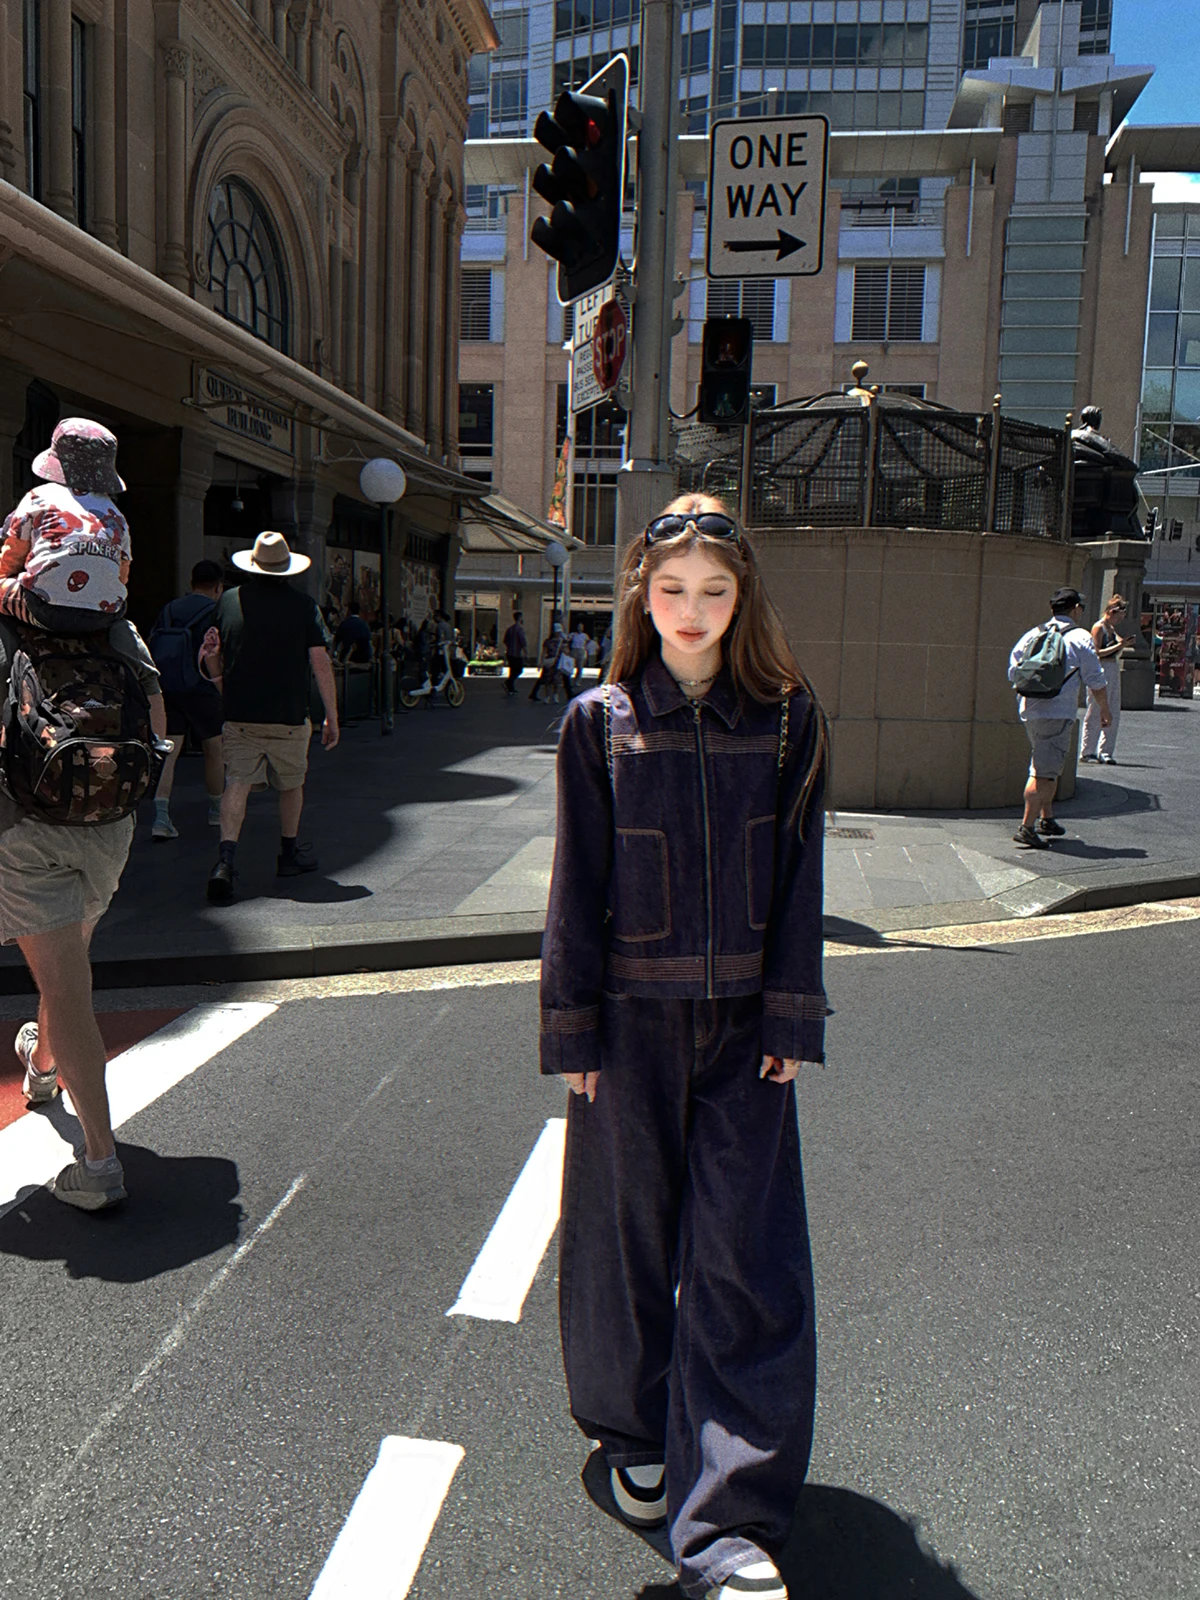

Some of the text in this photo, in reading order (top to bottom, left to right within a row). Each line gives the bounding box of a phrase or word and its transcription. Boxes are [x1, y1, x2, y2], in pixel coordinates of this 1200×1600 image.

[729, 131, 808, 170] ONE
[726, 181, 808, 219] WAY
[579, 287, 606, 316] LEFT
[595, 323, 625, 368] STOP
[206, 375, 243, 408] QUEEN
[227, 406, 272, 441] BUILDING
